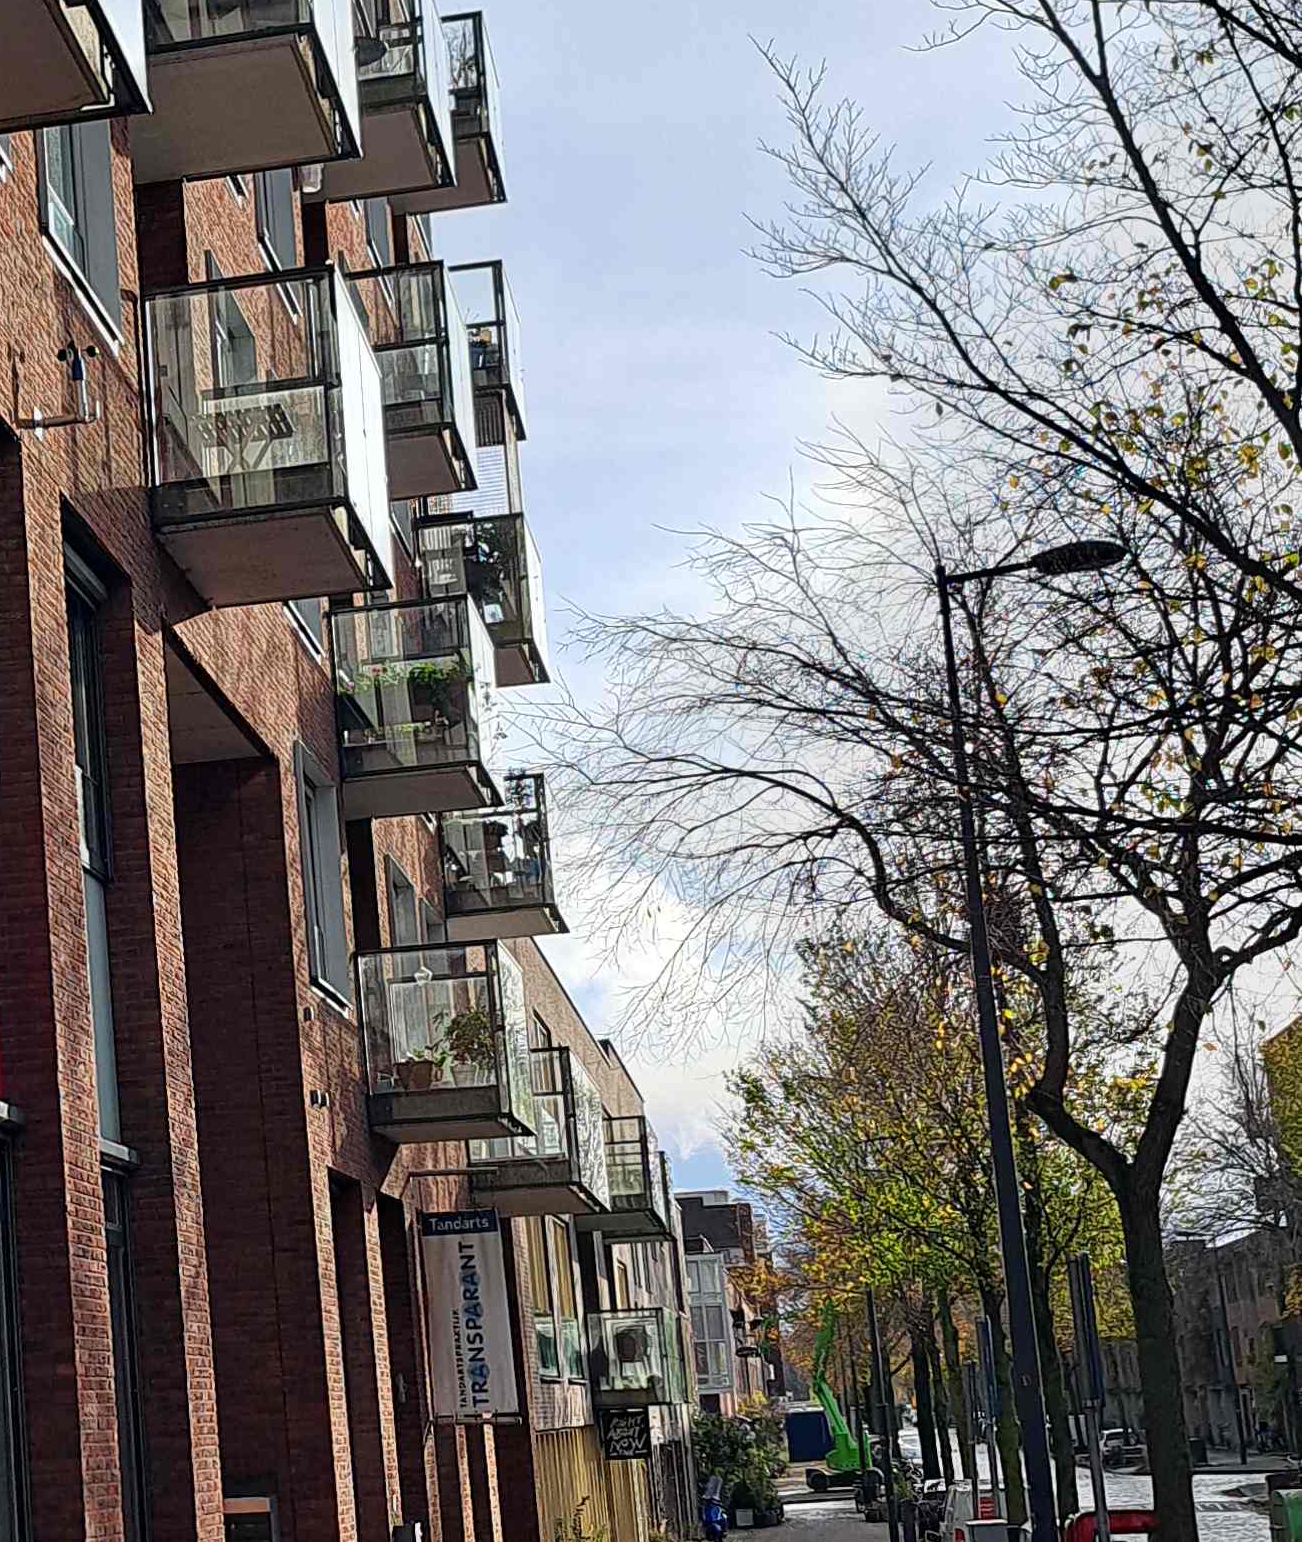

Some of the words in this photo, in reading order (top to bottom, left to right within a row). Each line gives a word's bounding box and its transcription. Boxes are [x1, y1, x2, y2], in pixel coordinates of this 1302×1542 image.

[428, 1216, 490, 1232] Tandarts
[458, 1241, 490, 1408] TRANSPARANT
[609, 1433, 648, 1452] NOW
